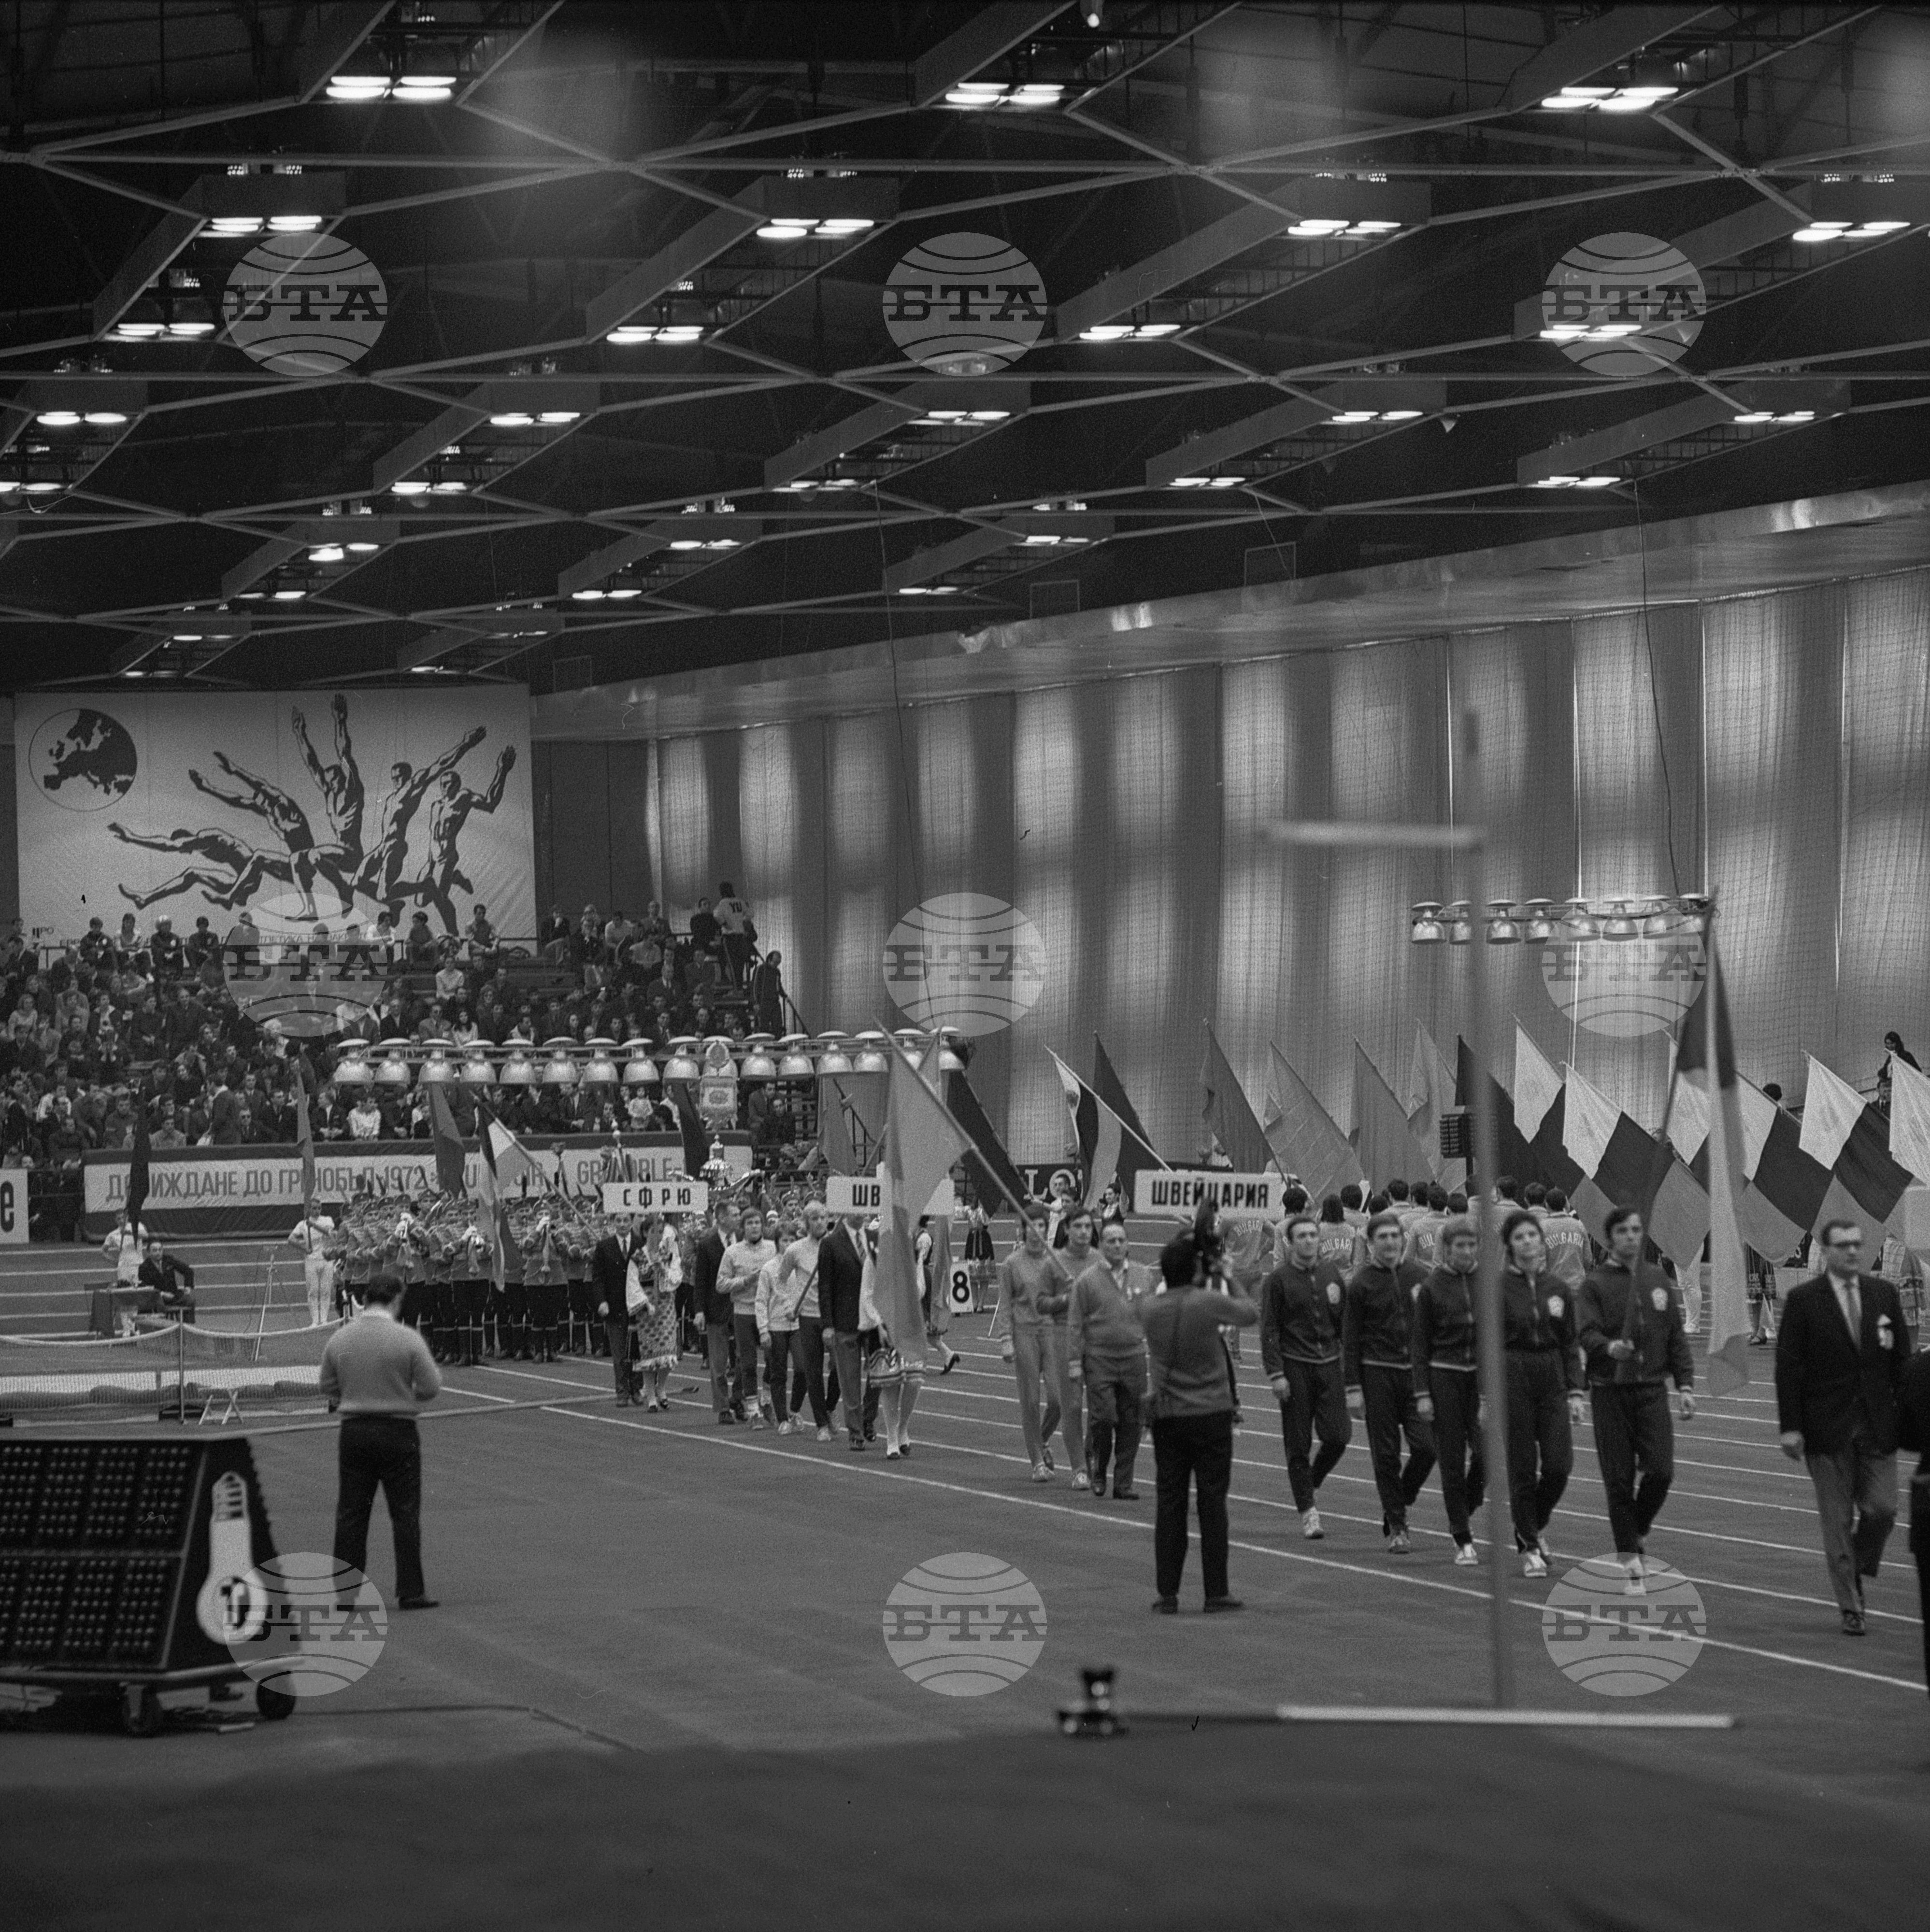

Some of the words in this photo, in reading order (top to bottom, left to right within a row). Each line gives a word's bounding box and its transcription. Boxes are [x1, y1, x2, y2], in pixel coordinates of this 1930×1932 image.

[106, 1171, 238, 1202] ДИЖДАНЕ
[243, 1169, 272, 1198] ДО
[853, 1184, 881, 1206] ШВ
[1152, 1177, 1268, 1210] ШВЕЙЦАРИЯ
[623, 1187, 691, 1208] СФРЮ
[1320, 1238, 1353, 1254] BULGARI
[1418, 1234, 1435, 1249] BUL
[952, 1271, 970, 1303] 8
